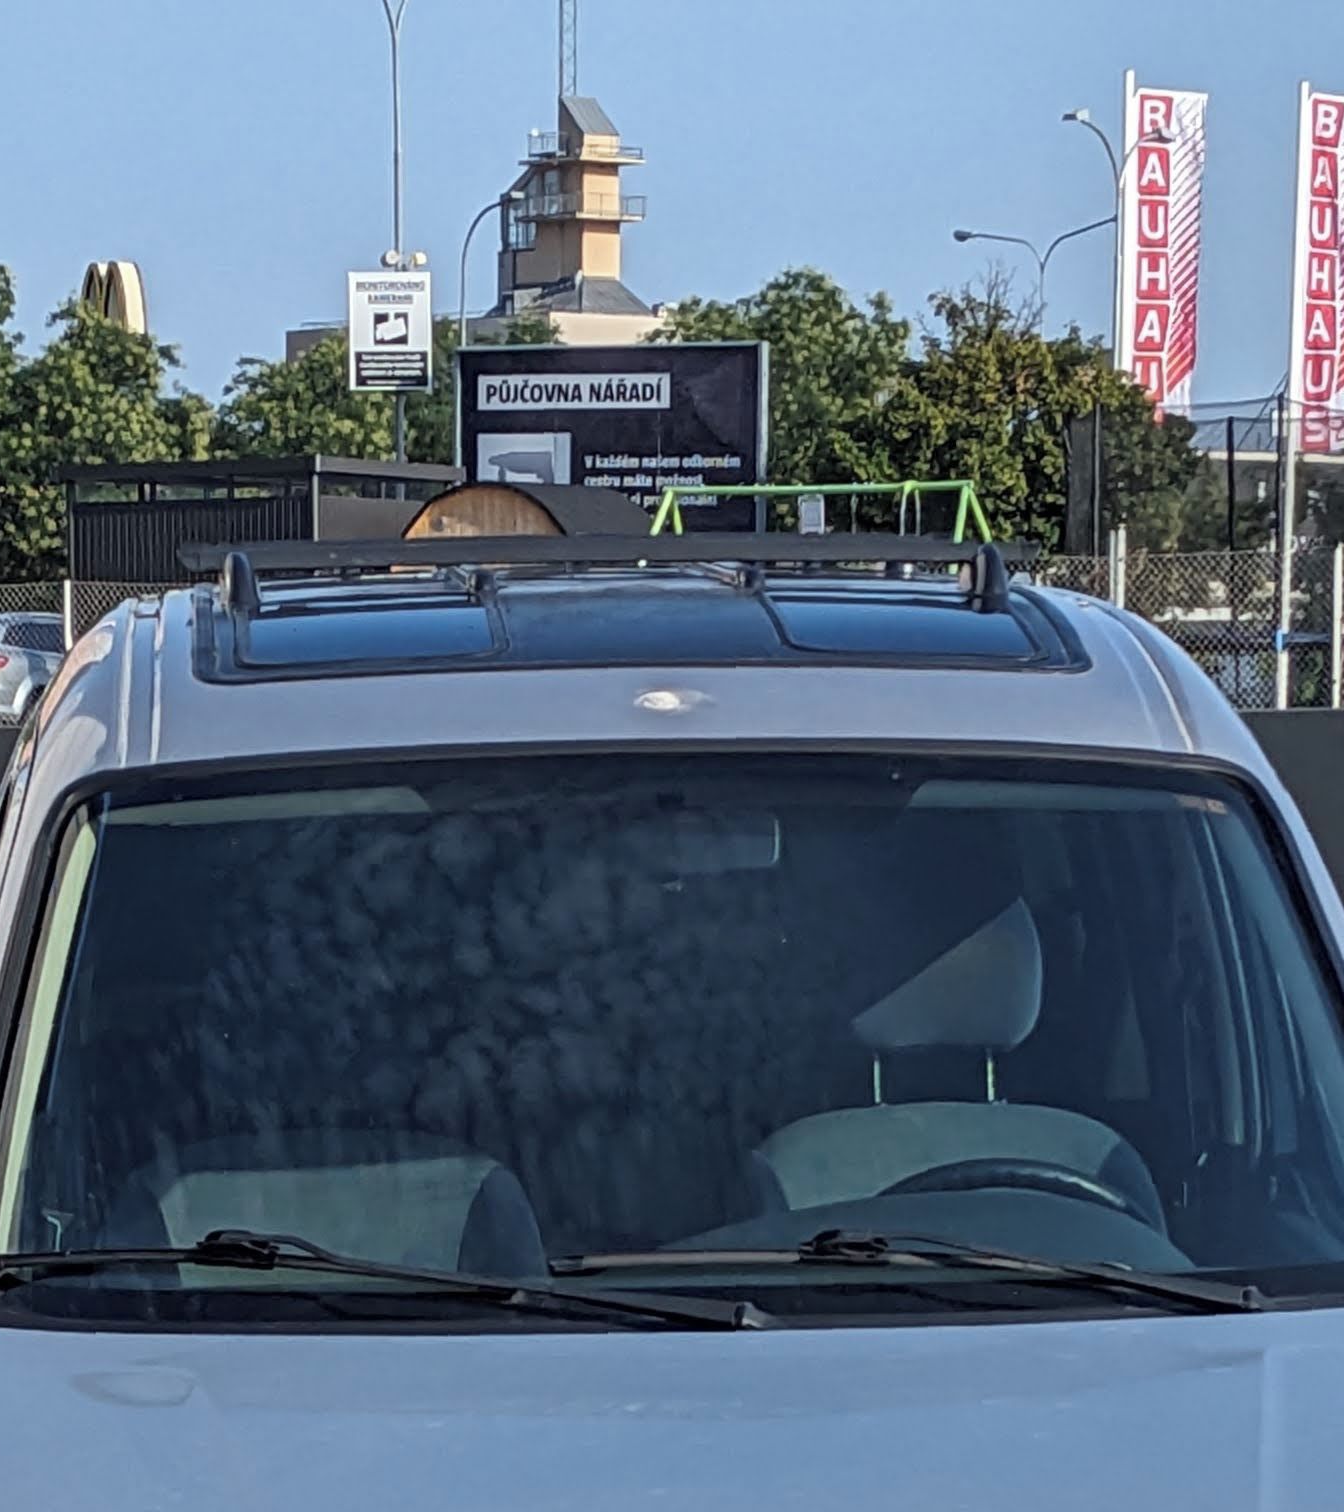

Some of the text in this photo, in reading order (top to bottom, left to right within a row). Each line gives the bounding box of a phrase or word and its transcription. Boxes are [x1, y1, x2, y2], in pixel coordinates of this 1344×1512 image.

[1304, 103, 1340, 444] BAUHAUS
[485, 376, 663, 405] PŮJČOVNA NÁŘADÍ
[584, 455, 594, 469] V
